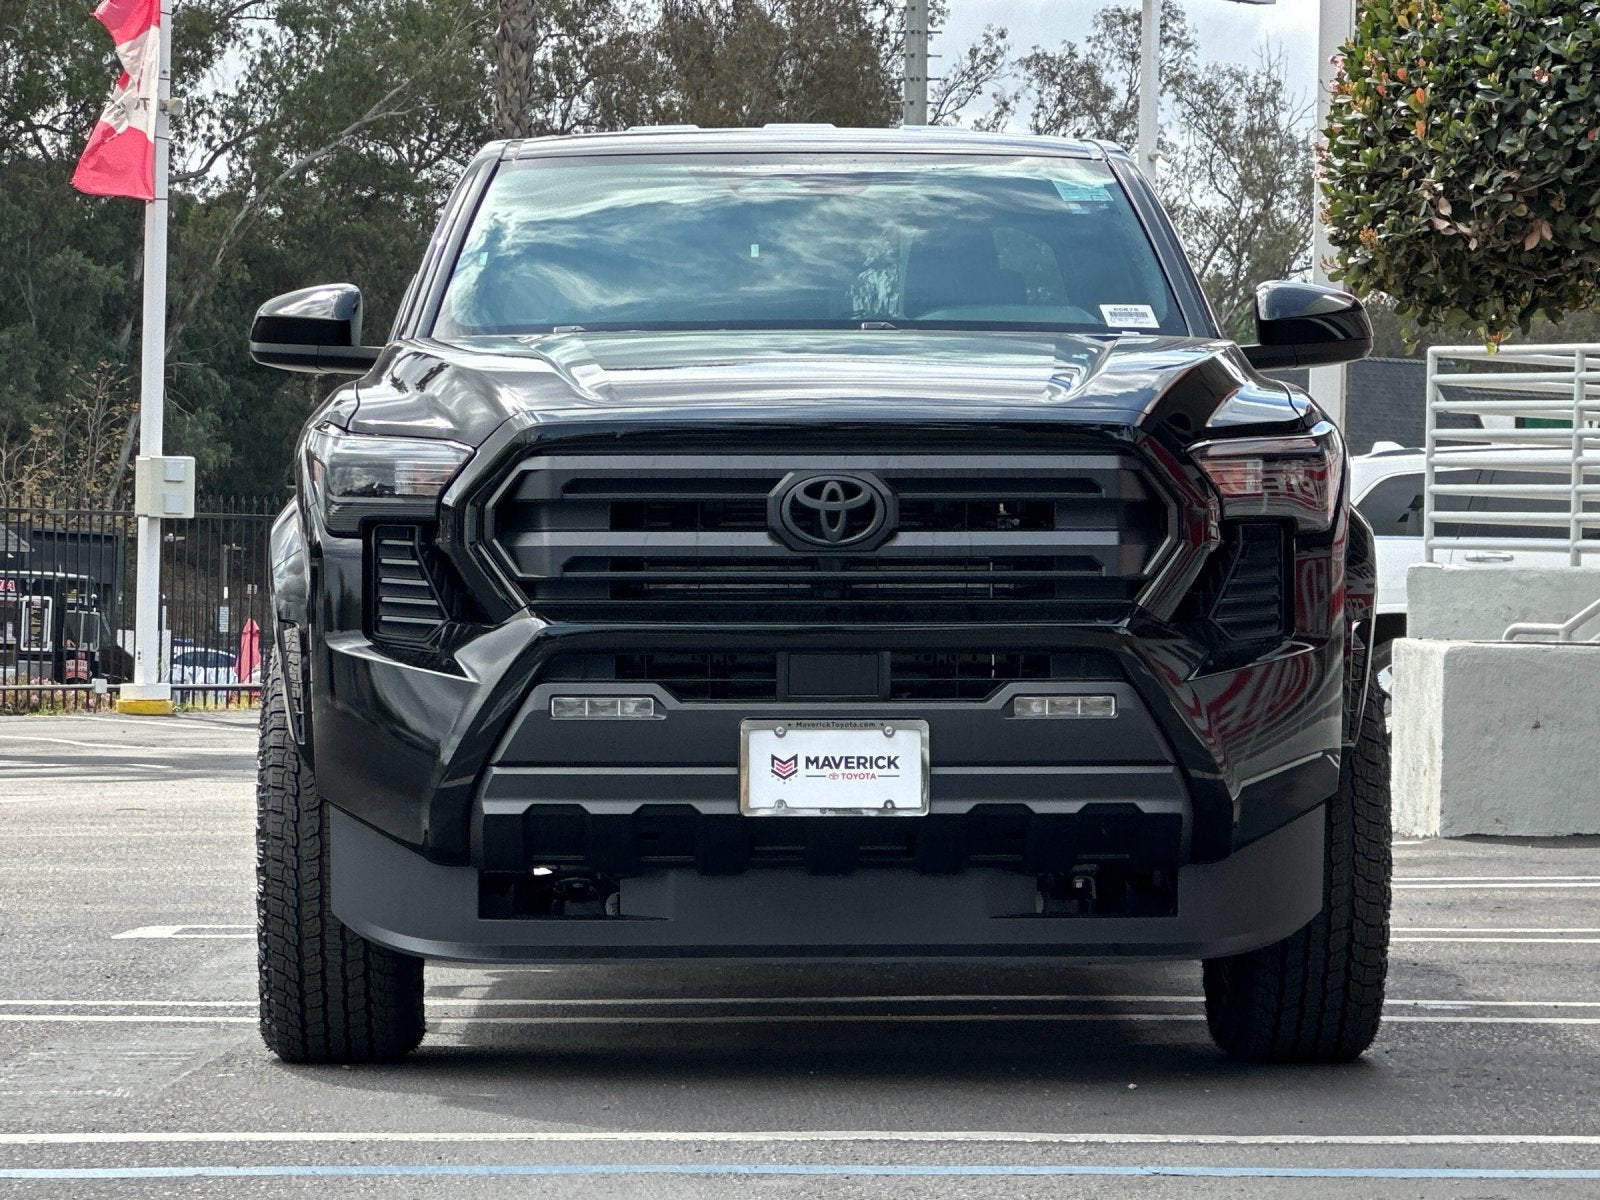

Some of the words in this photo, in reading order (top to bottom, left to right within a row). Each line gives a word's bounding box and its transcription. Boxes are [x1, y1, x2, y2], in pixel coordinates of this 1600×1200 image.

[796, 721, 876, 729] MaverickToyota.com
[805, 755, 900, 770] MAVERICK
[841, 772, 877, 780] TOYOTA
